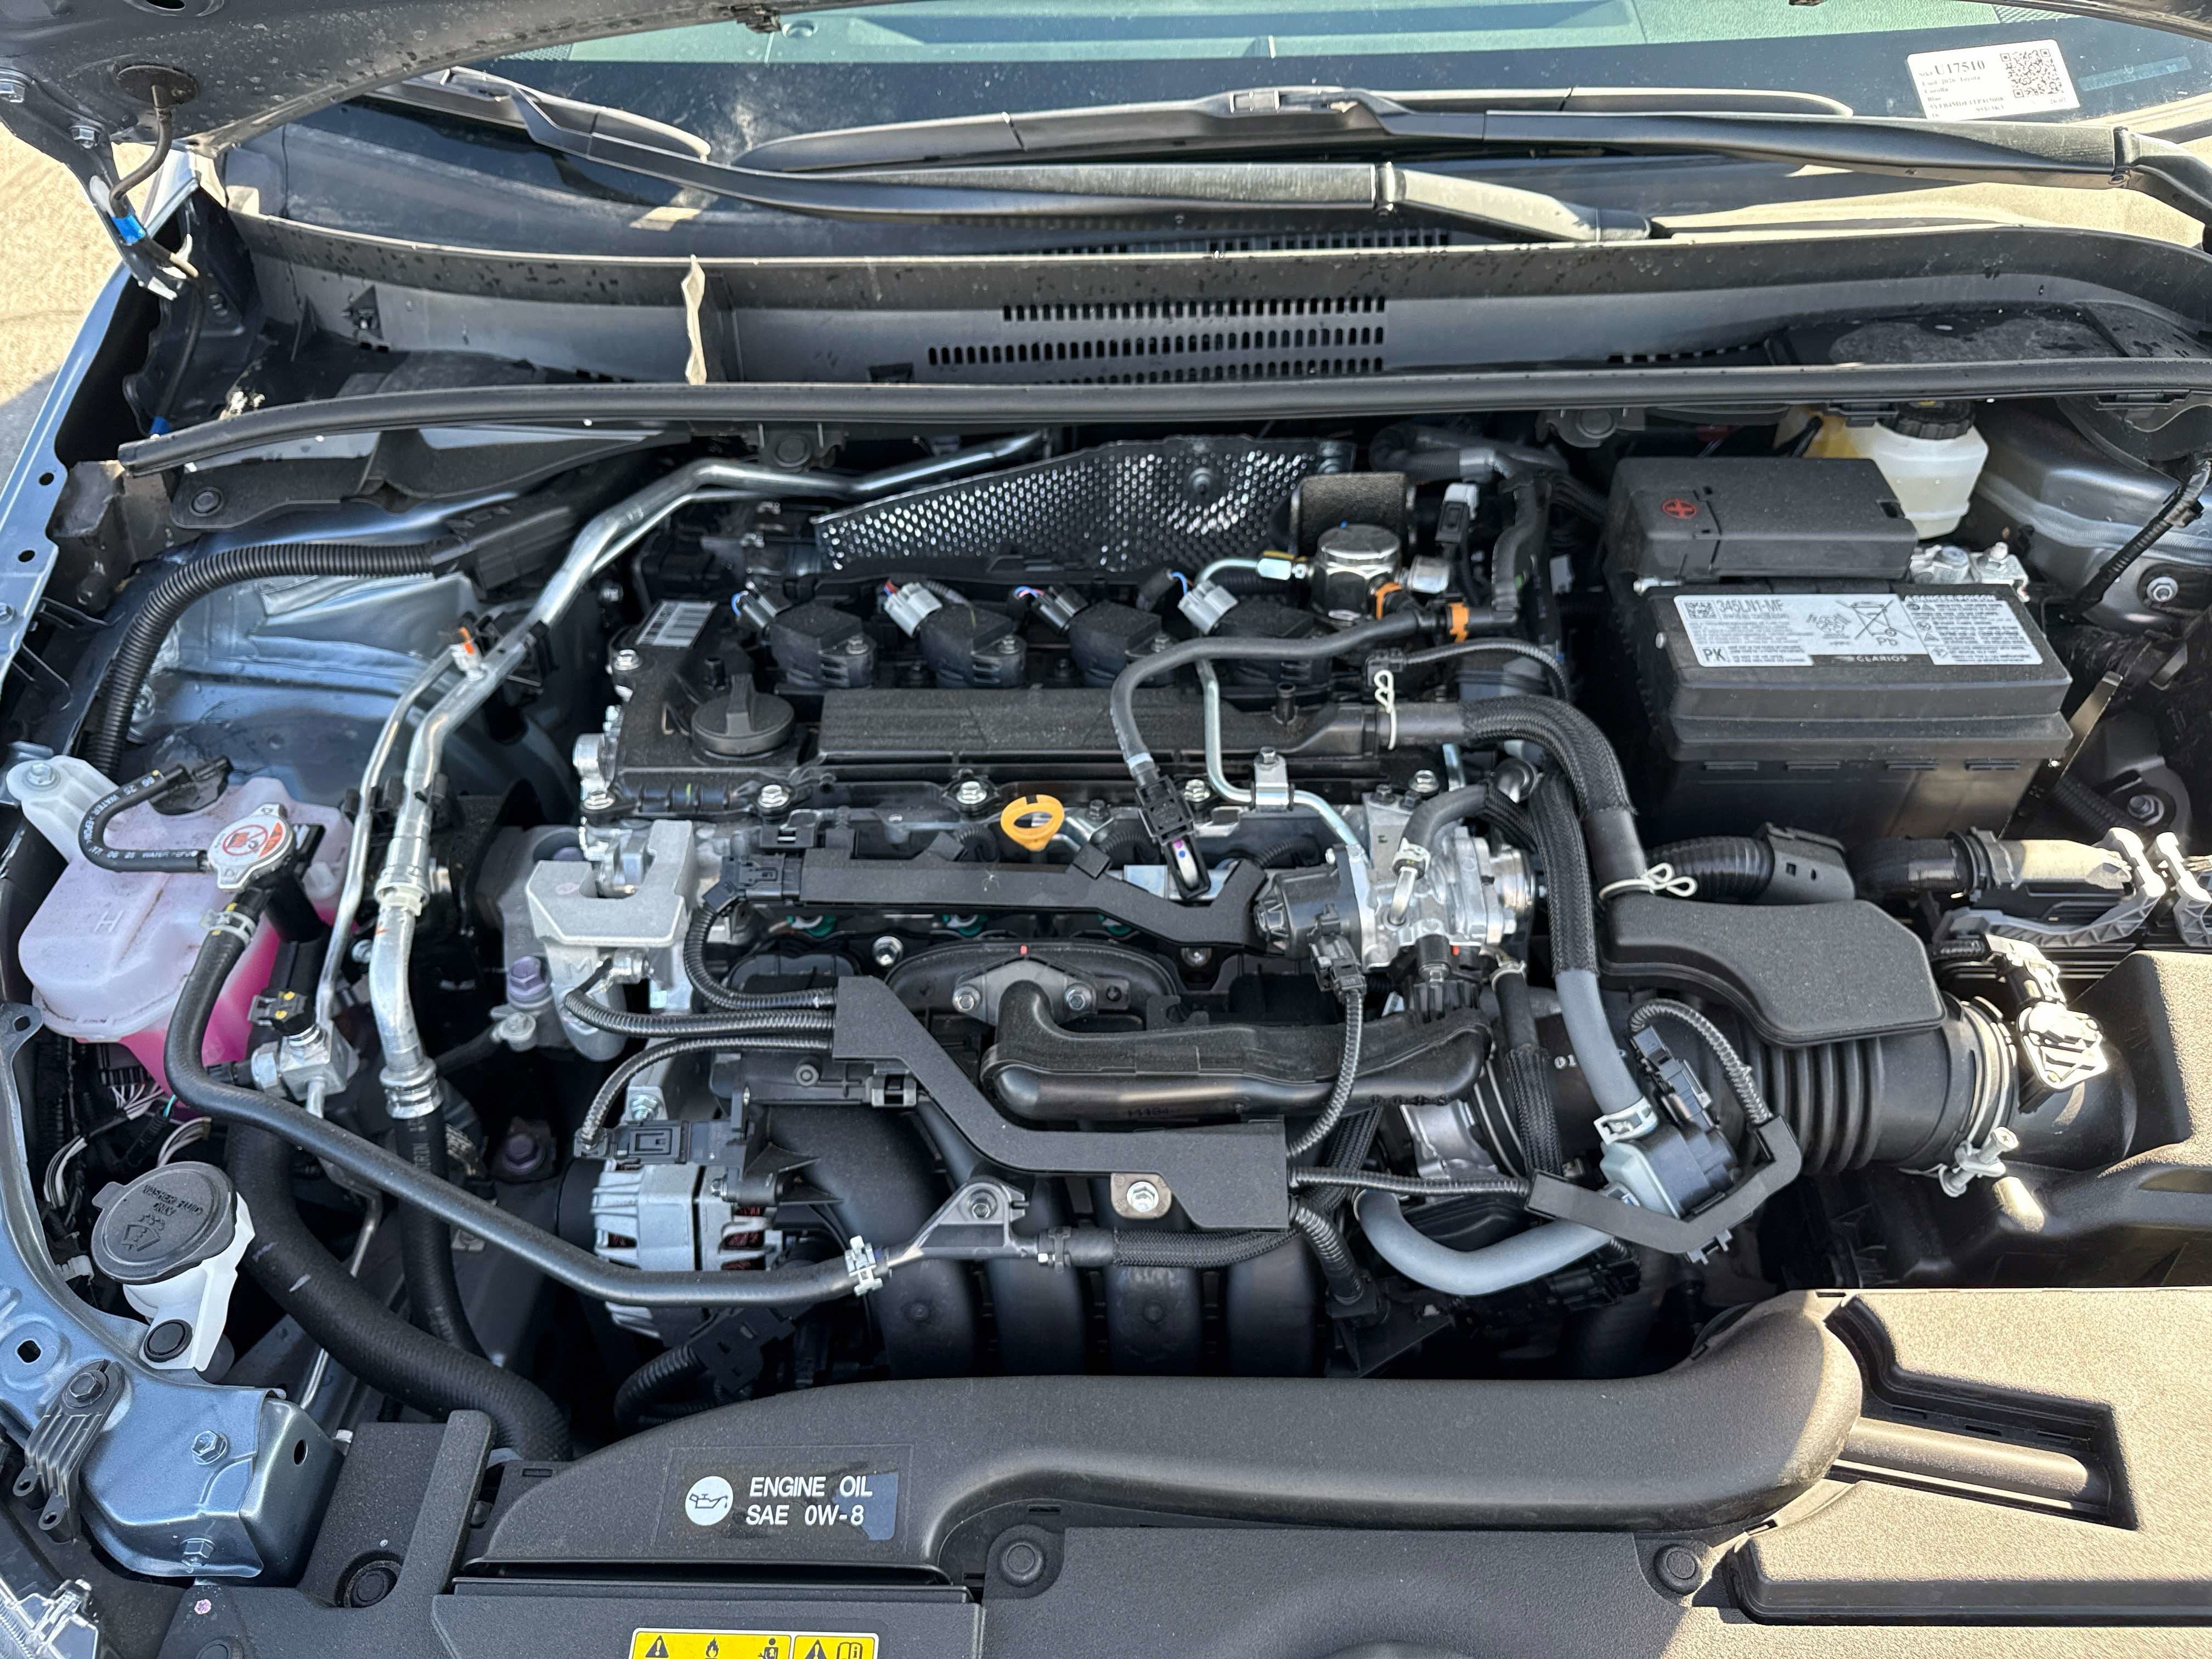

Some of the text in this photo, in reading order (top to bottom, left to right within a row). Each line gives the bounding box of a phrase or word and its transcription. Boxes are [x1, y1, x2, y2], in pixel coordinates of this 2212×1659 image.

[1934, 60, 1985, 75] U17510
[1702, 648, 1726, 662] PK
[143, 1184, 204, 1216] WASHER FLUID
[153, 1202, 176, 1216] ONLY
[749, 1475, 873, 1497] ENGINE OIL
[746, 1504, 865, 1526] SAE 0W-8
